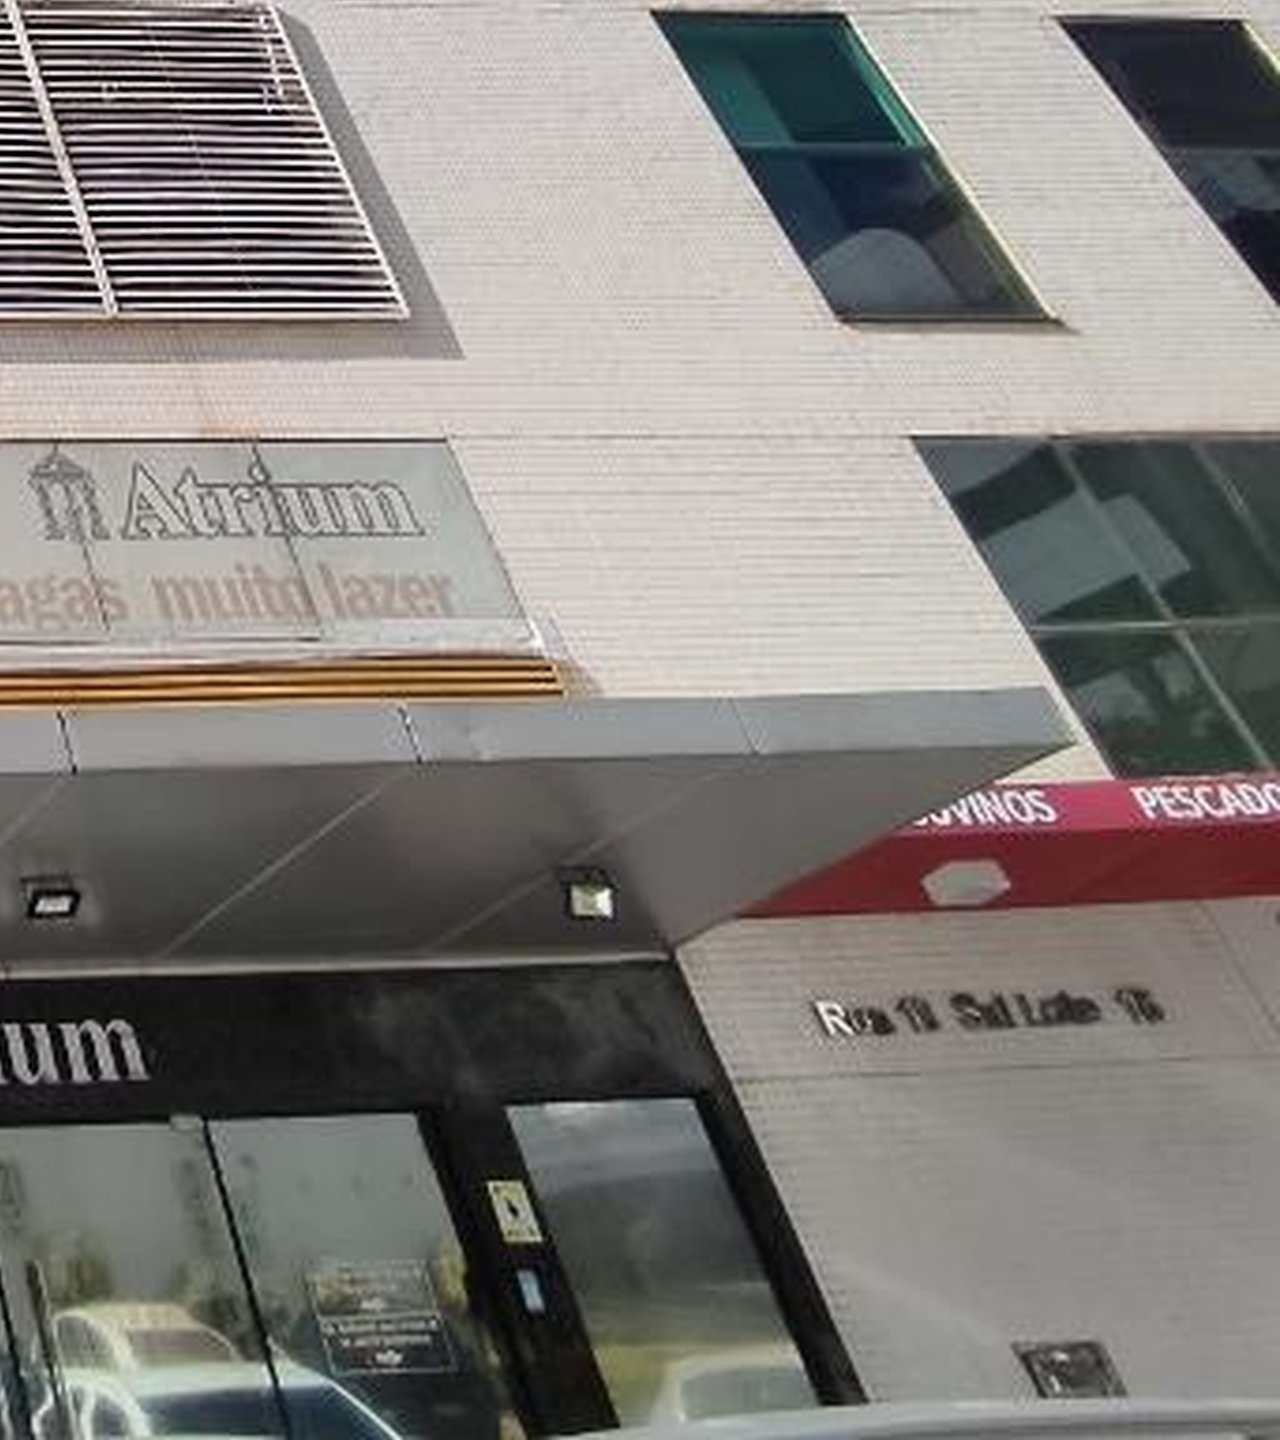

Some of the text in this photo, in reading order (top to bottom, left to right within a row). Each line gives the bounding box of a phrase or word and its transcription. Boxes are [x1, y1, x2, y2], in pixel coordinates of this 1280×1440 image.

[120, 460, 426, 540] Atrium
[151, 562, 317, 626] muito
[320, 560, 453, 620] lazer
